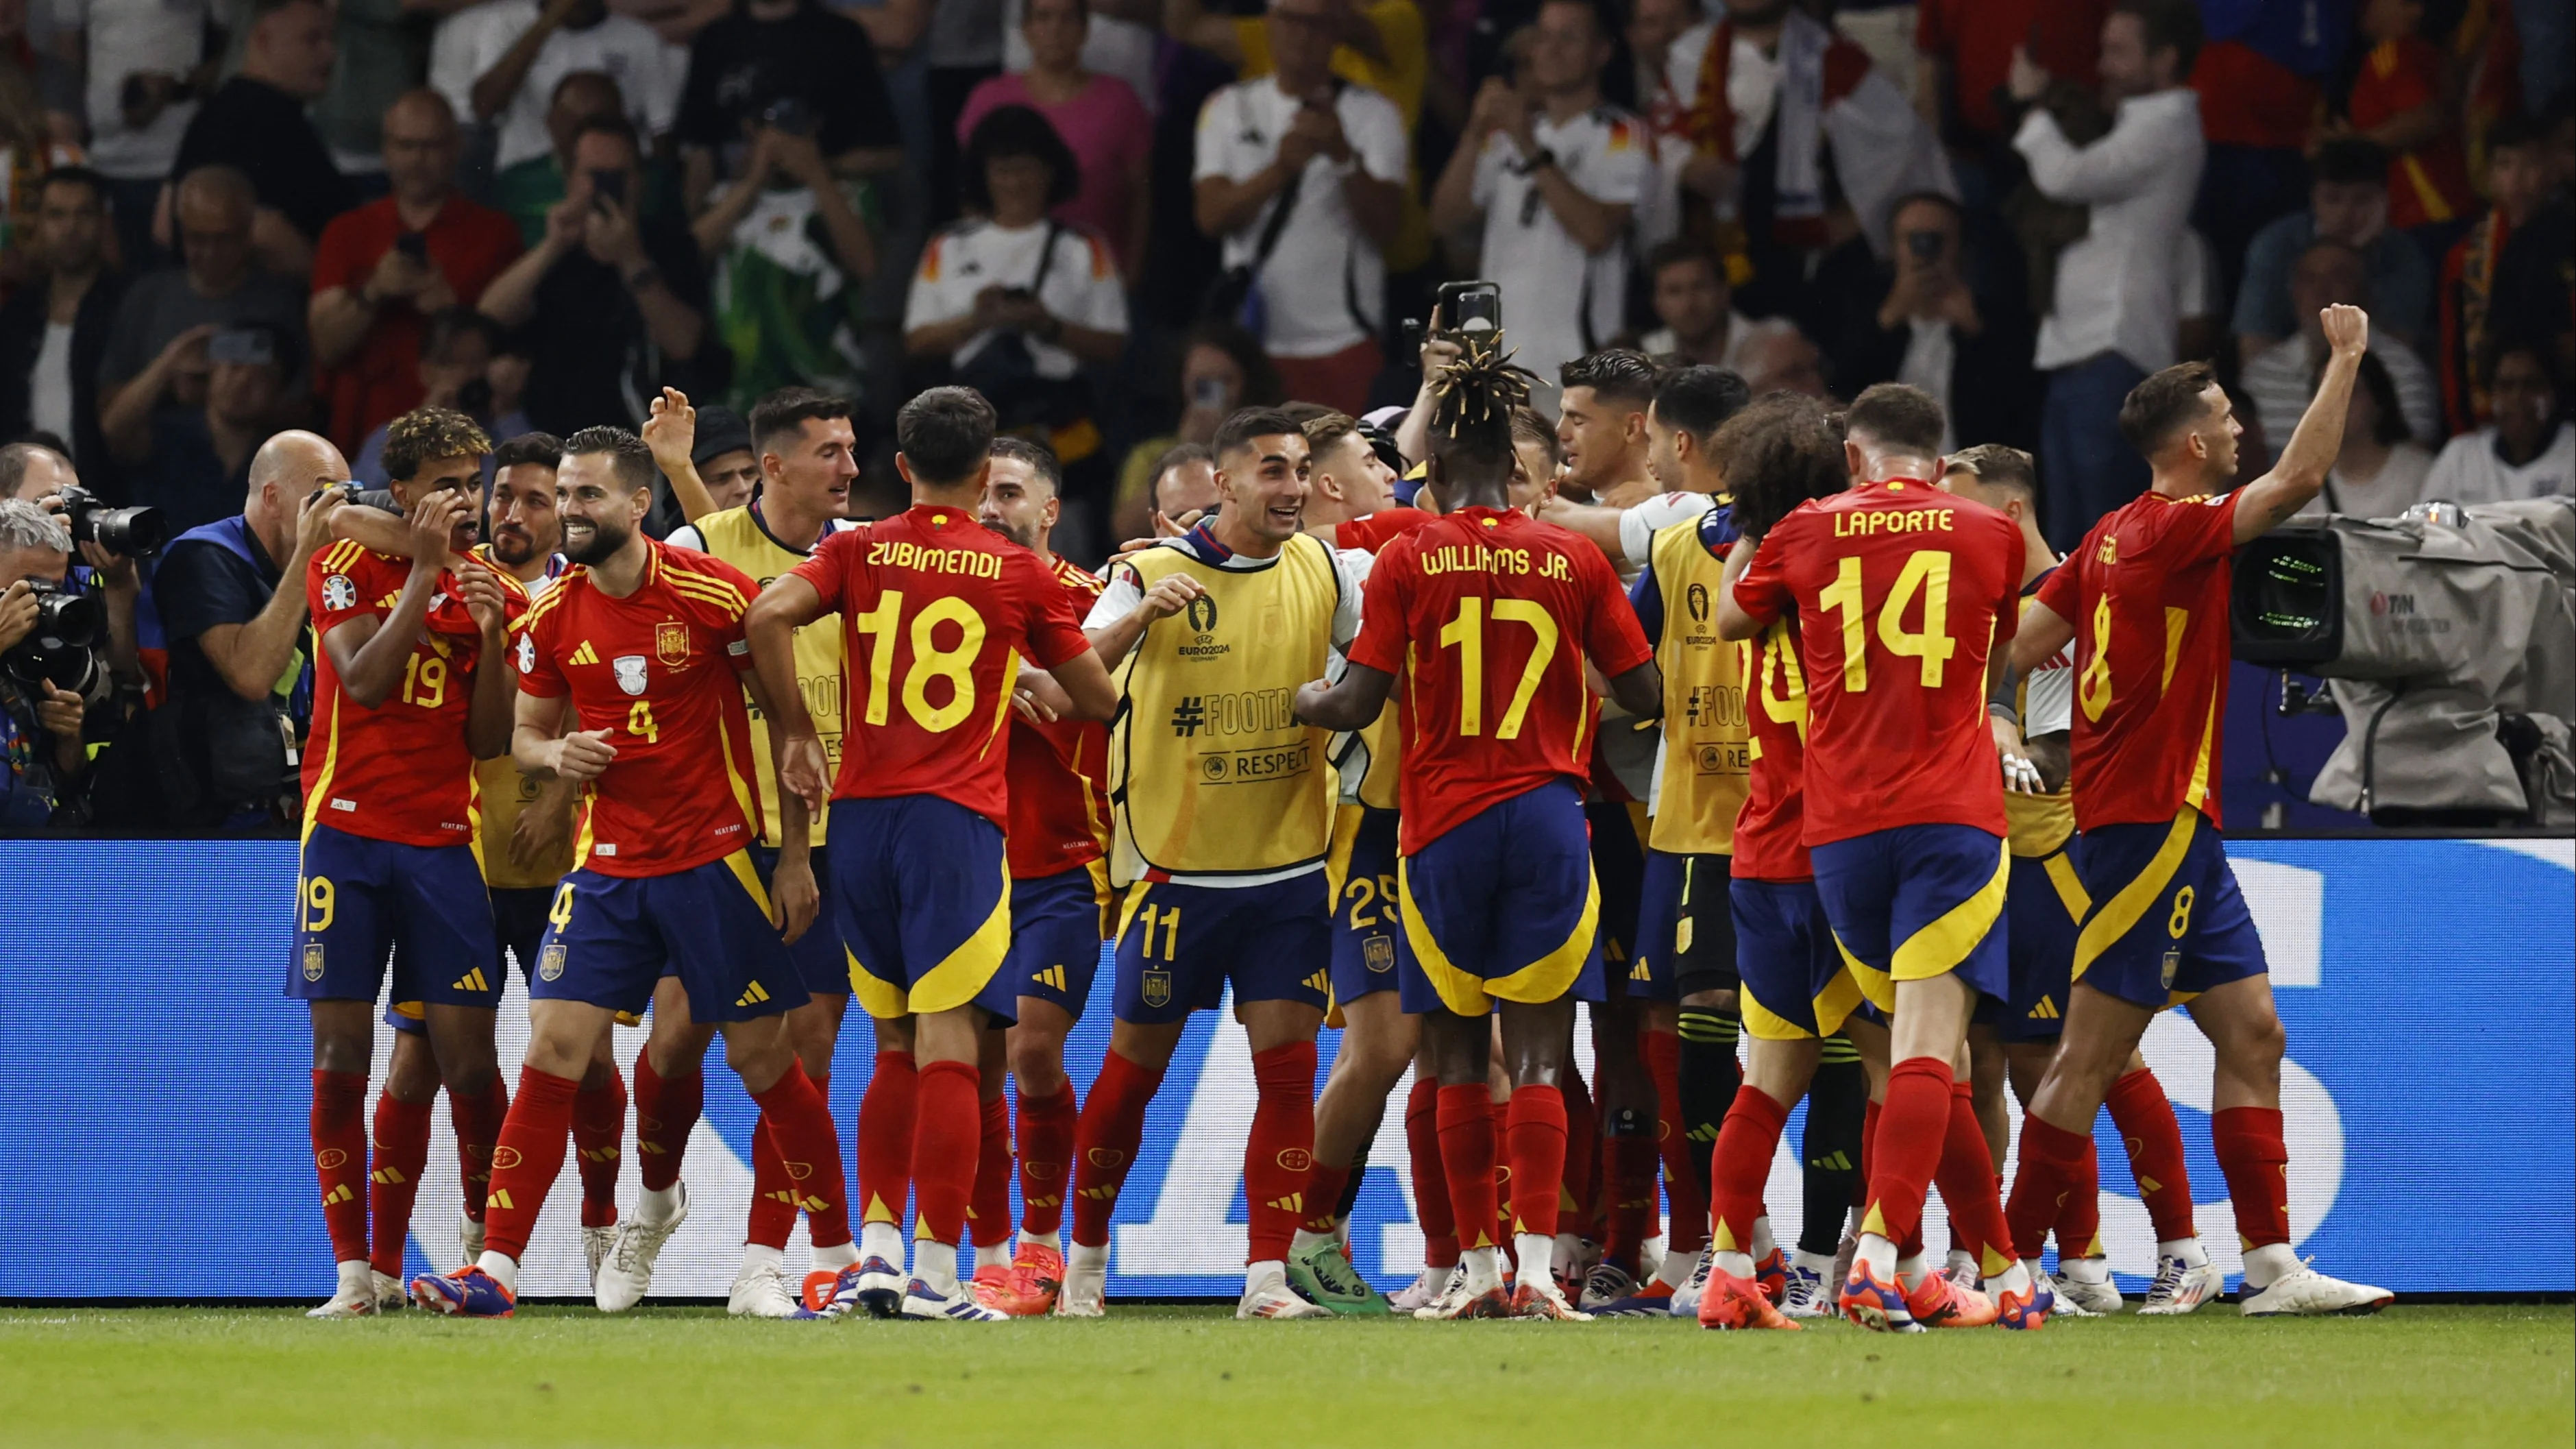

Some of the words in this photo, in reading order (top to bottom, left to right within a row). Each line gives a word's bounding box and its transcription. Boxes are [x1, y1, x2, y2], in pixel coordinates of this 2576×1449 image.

[1834, 509, 1954, 537] LAPORTE
[867, 541, 1003, 580] ZUBIMENDI
[1421, 545, 1530, 576] WILLIAMS
[1538, 552, 1573, 583] JR.
[1819, 550, 1955, 692] 14
[857, 589, 986, 733] 18
[1179, 644, 1229, 656] EURO2024
[1440, 596, 1558, 740] 17
[2079, 592, 2112, 722] 8
[402, 652, 446, 709] 19
[627, 700, 658, 744] 4
[1171, 687, 1299, 738] #FOOTB
[1237, 746, 1310, 777] RESPECT
[301, 875, 334, 932] 19
[549, 882, 576, 934] 4
[1345, 874, 1399, 931] 25
[2168, 884, 2194, 940] 8
[1140, 903, 1181, 962] 11
